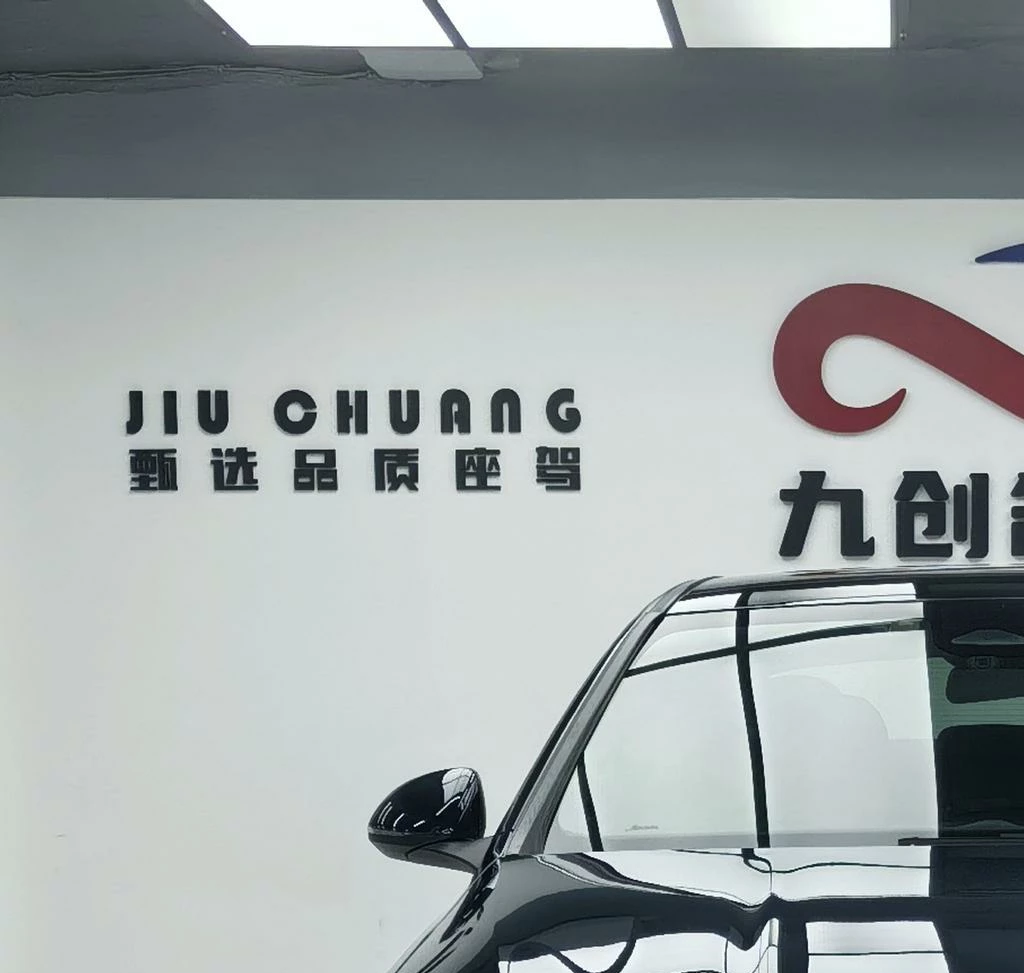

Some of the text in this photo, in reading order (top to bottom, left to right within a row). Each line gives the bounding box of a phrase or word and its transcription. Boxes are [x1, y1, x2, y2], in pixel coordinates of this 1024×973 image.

[125, 388, 582, 435] JIU CHUANG
[128, 446, 581, 492] 甄选品质座驾
